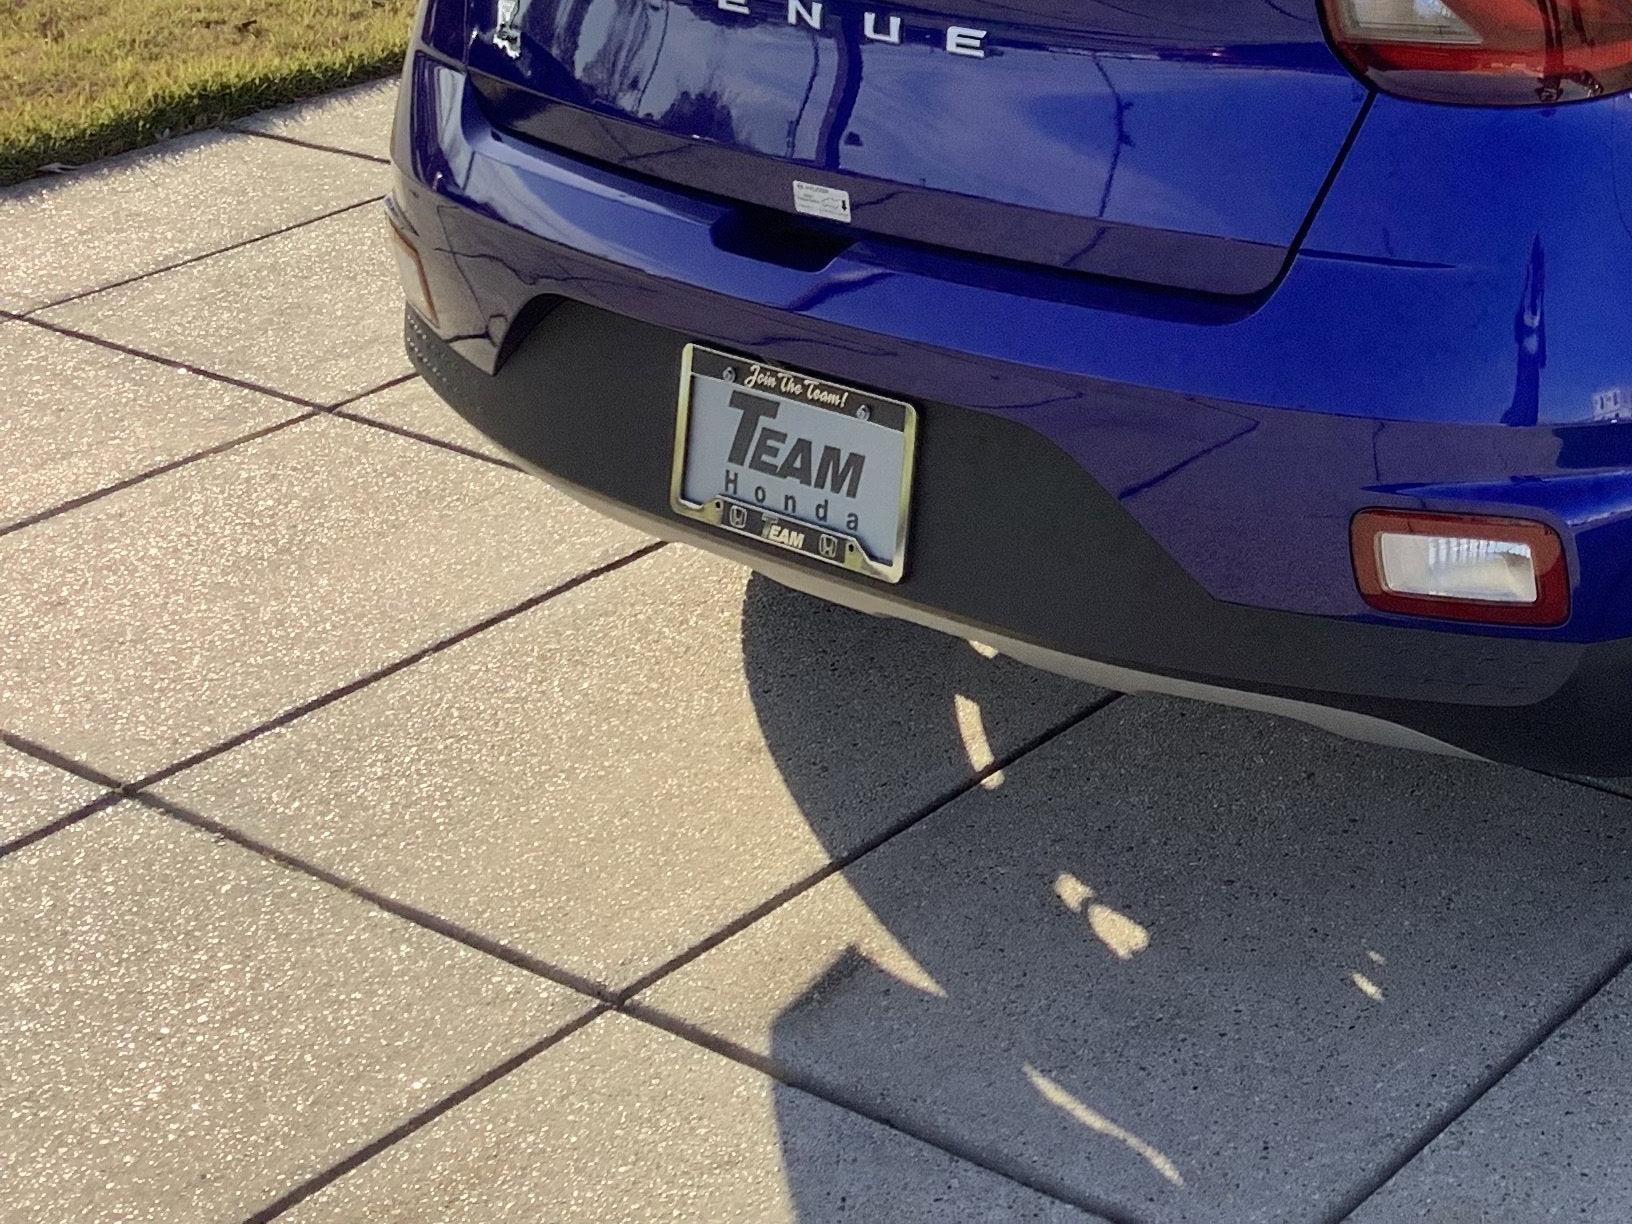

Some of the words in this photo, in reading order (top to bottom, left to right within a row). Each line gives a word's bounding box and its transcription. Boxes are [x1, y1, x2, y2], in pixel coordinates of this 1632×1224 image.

[744, 364, 777, 388] Join
[778, 372, 803, 395] The
[803, 379, 849, 408] Team!
[727, 390, 866, 499] TEAM
[724, 469, 859, 531] Honda
[761, 511, 806, 549] TEAM
